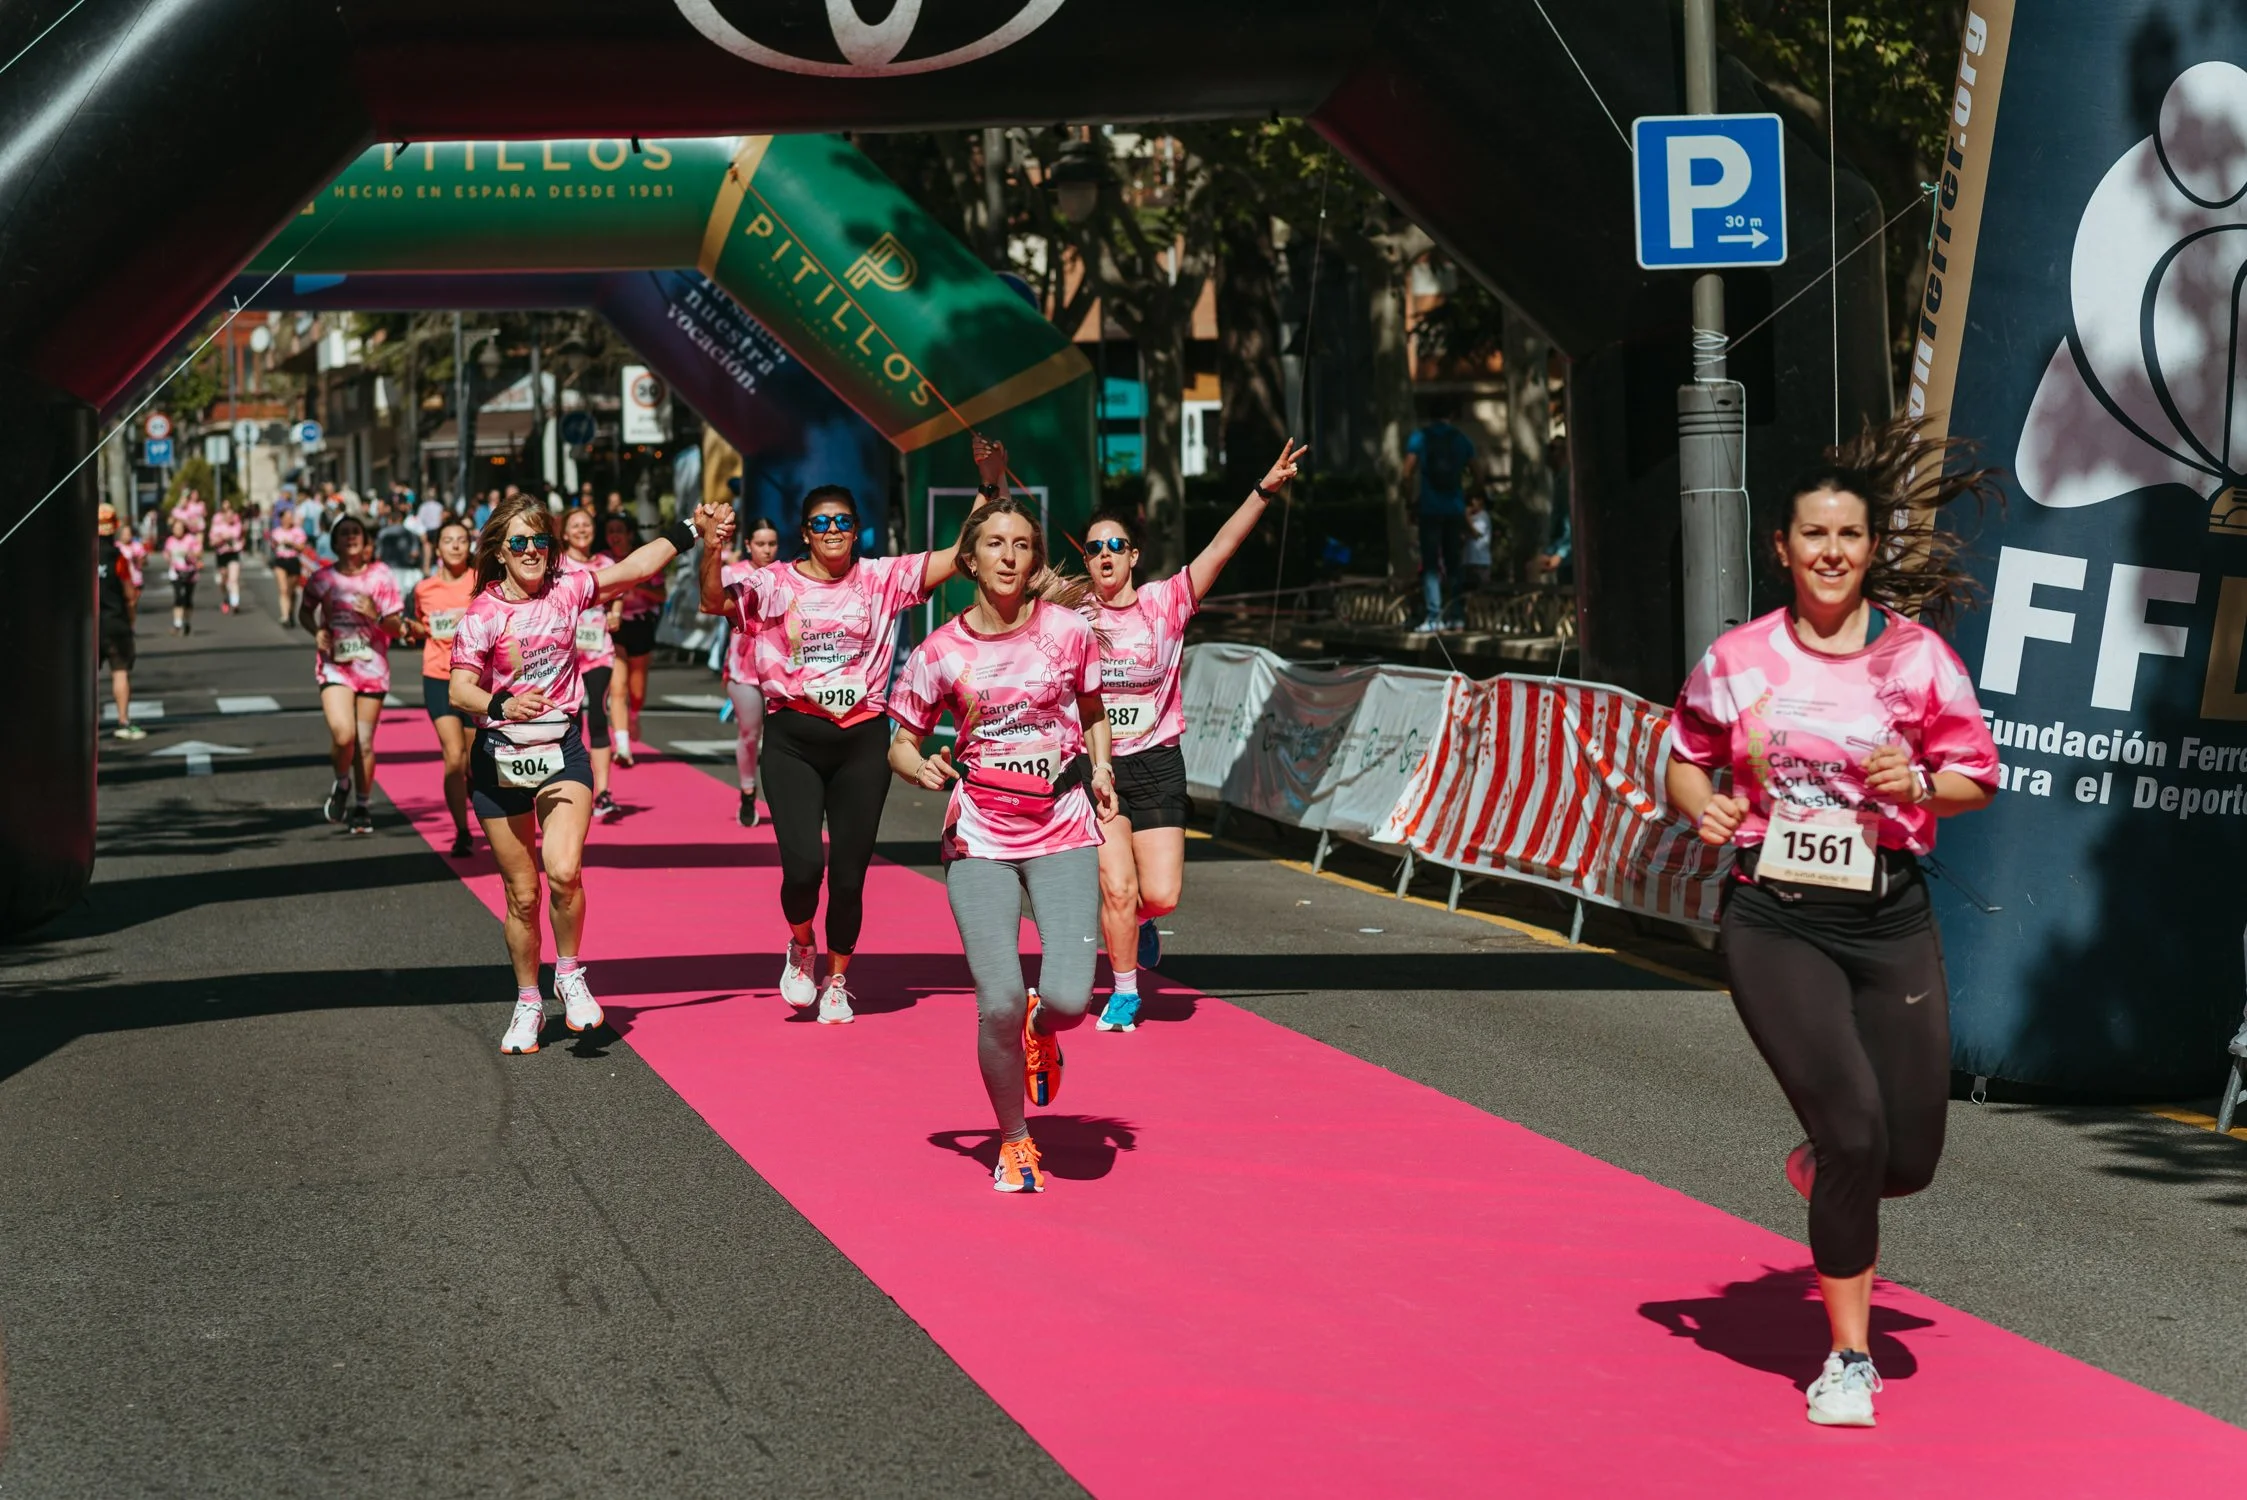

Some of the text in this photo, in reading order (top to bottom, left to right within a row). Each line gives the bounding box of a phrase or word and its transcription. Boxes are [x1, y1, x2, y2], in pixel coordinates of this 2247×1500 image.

[334, 183, 675, 198] HECHO EN ESPAÑA DESDE 1981
[1666, 135, 1752, 249] P
[1725, 215, 1762, 228] 30 m
[745, 213, 930, 406] PITILLOS
[685, 289, 775, 376] nuestra
[667, 303, 756, 395] vocación.
[801, 619, 812, 629] XI
[519, 638, 529, 648] XI
[801, 630, 845, 641] Carrera
[521, 643, 556, 660] Carrera
[802, 642, 834, 655] por la
[523, 658, 548, 673] por la
[1101, 656, 1136, 666] arrera
[1101, 667, 1124, 678] or la
[1102, 677, 1162, 689] vestigación
[976, 689, 990, 703] XI
[979, 700, 1028, 716] Carrera
[982, 715, 1016, 728] por la
[1767, 729, 1788, 747] XI
[512, 757, 550, 776] 804
[1768, 752, 1842, 774] Carrera
[1773, 773, 1826, 789] por la
[2075, 772, 2113, 805] el
[1783, 831, 1853, 866] 1561
